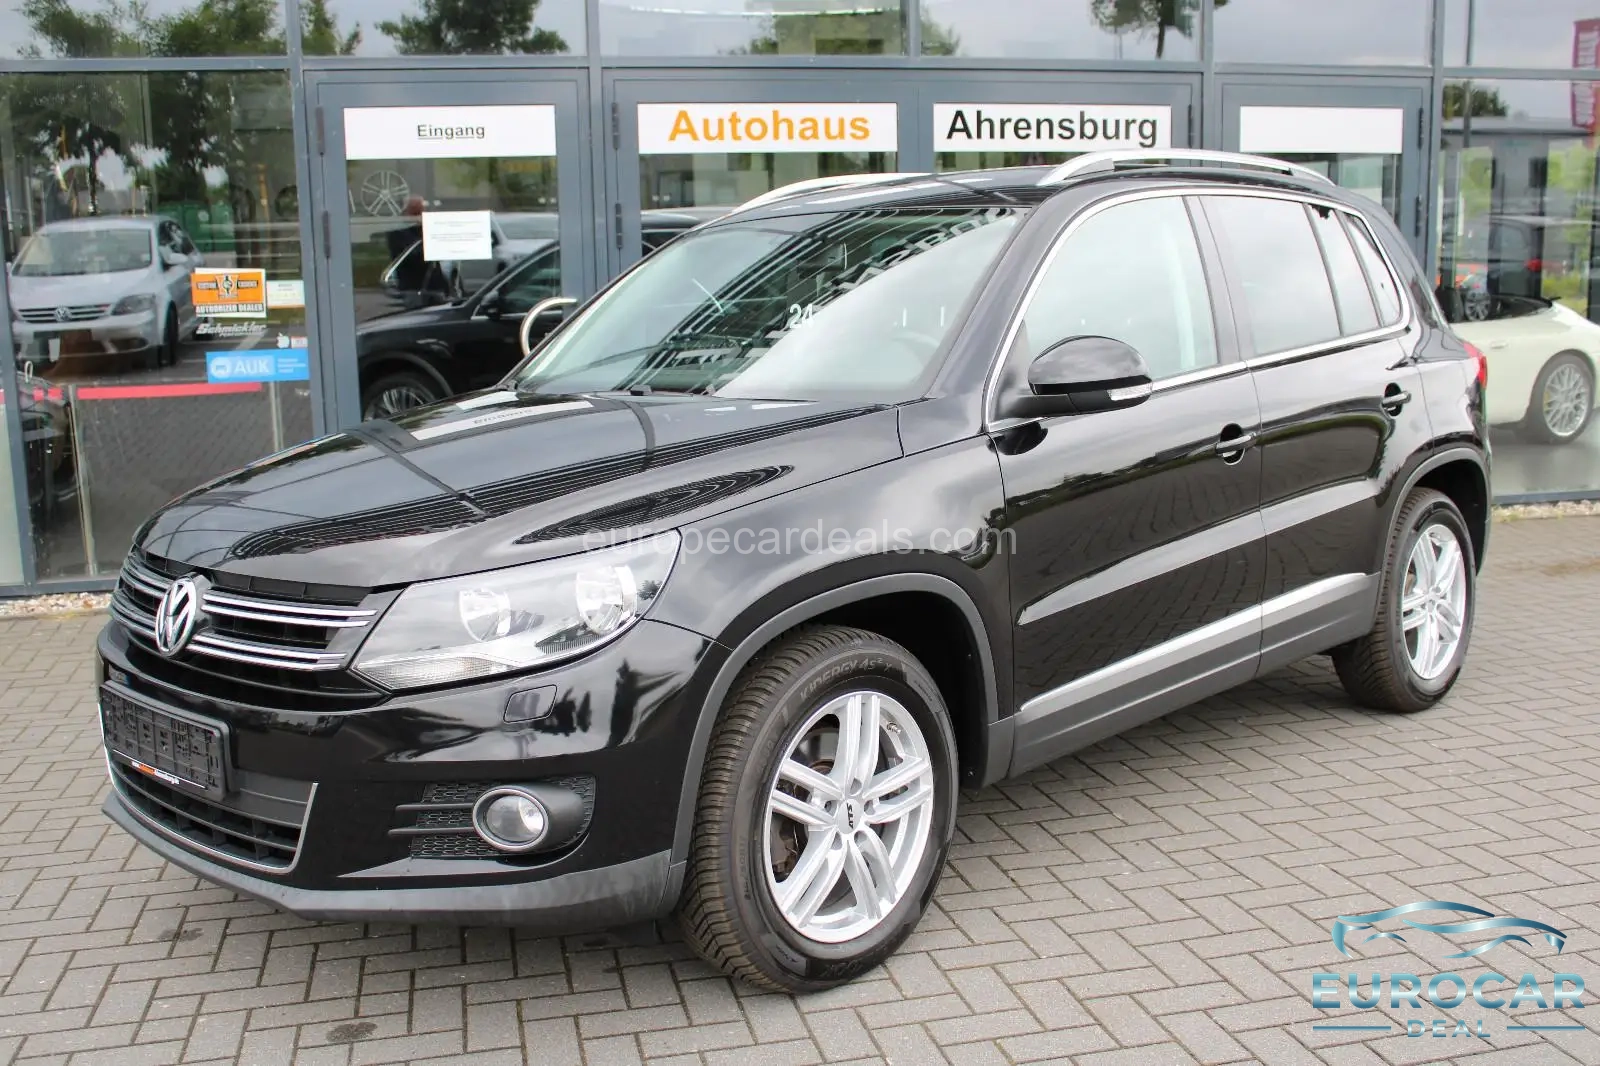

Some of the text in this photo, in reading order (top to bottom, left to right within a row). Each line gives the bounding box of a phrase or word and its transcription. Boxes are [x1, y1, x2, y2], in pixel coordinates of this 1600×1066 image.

[417, 124, 485, 139] Eingang
[669, 109, 1158, 149] Autohaus Ahrensburg
[195, 303, 264, 314] AUTHORIZED DEALER
[235, 358, 269, 374] AUK
